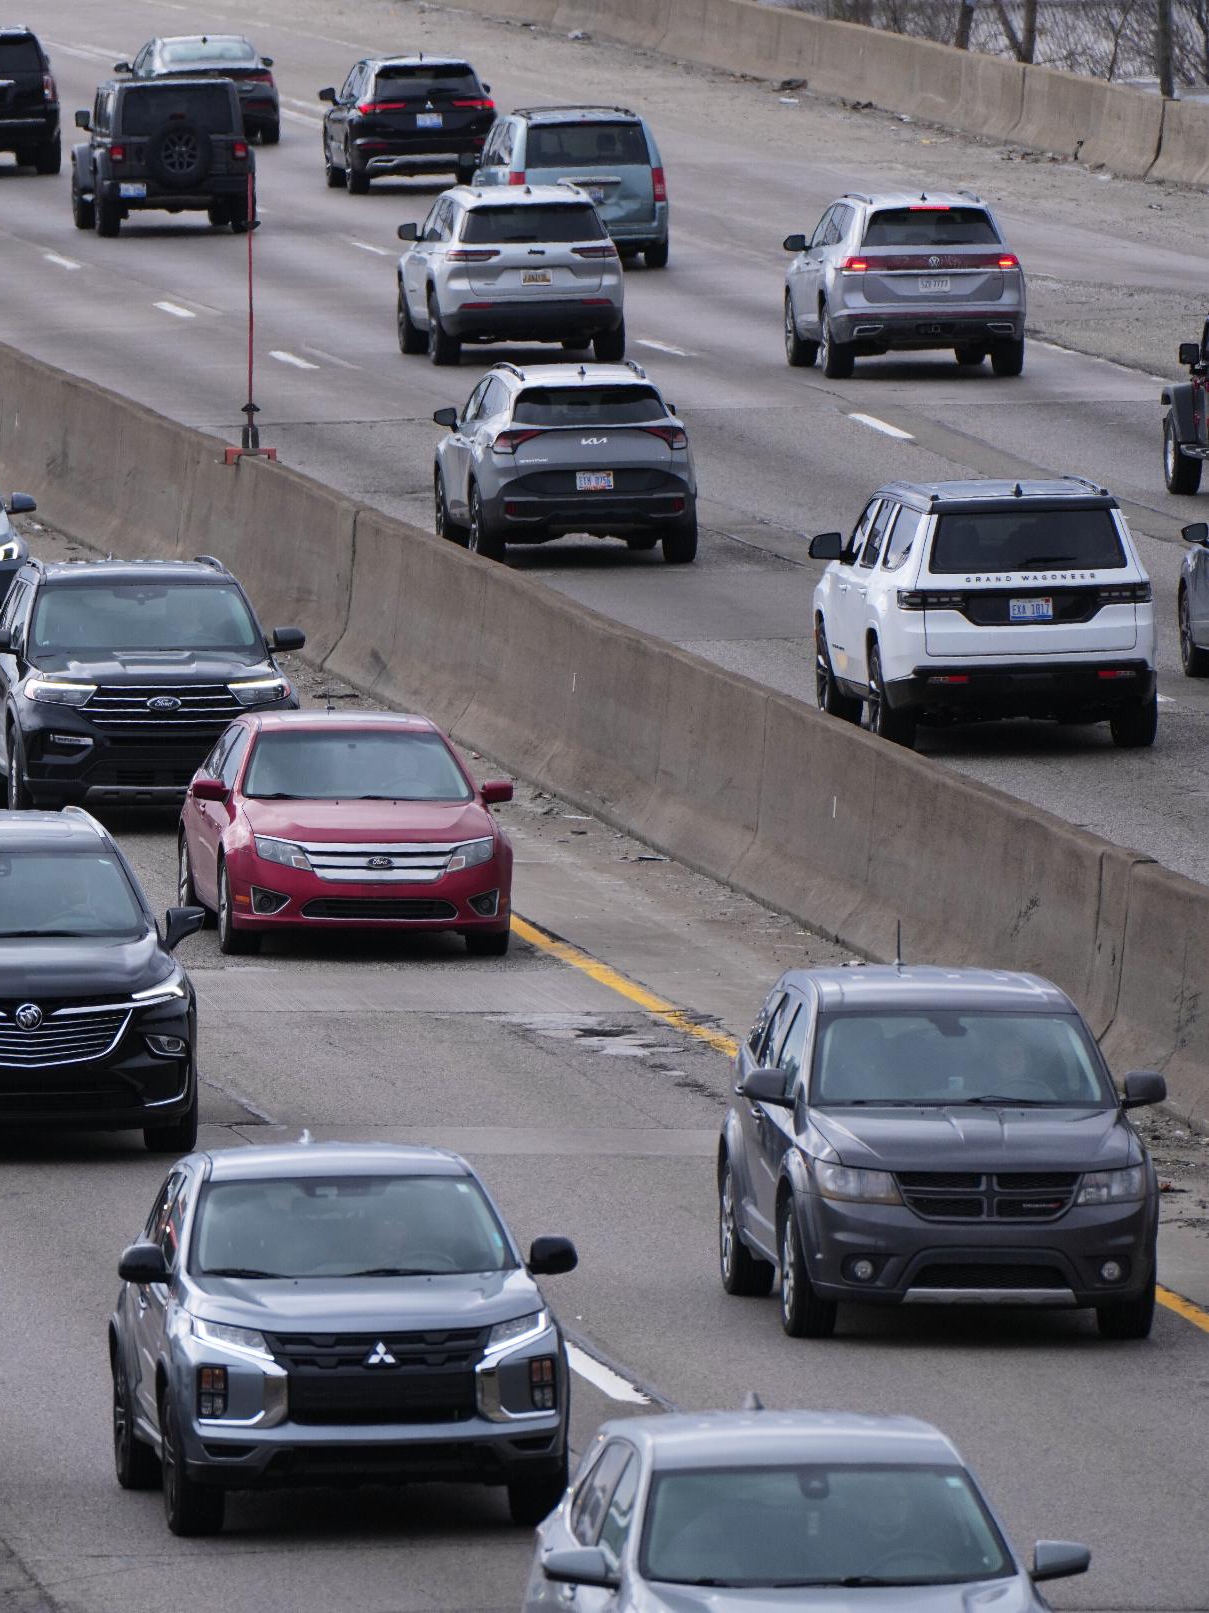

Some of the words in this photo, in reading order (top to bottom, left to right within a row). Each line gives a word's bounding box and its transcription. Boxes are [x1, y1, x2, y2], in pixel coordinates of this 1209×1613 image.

[965, 575, 1013, 583] GRAND
[1021, 573, 1096, 582] WAGONEER
[1013, 604, 1027, 616] EXA
